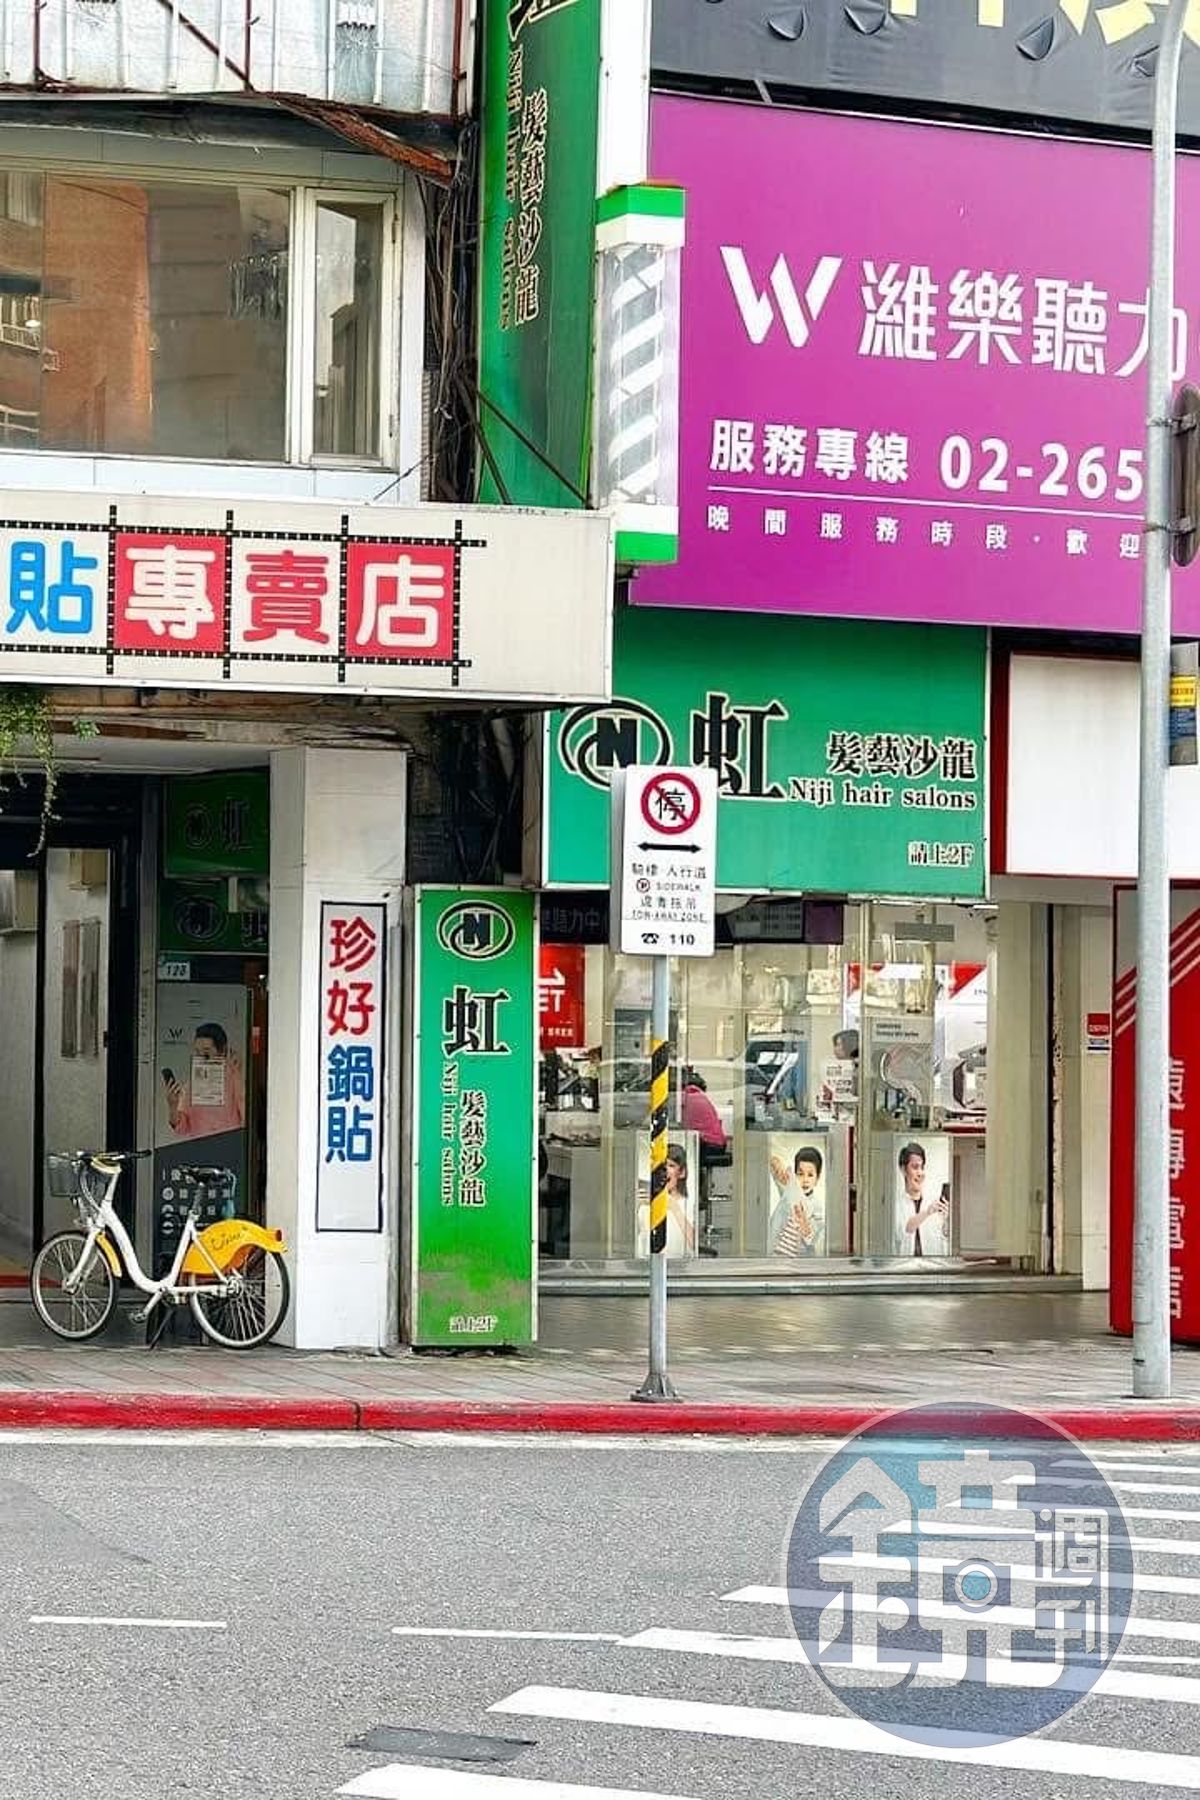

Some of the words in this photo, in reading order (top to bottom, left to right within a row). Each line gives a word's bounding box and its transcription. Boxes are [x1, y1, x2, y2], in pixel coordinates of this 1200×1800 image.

[515, 88, 547, 325] 髮藝沙龍
[709, 420, 909, 484] 服務專線
[693, 693, 788, 801] 虹
[828, 732, 978, 780] 髮藝沙龍
[790, 778, 836, 806] Niji
[843, 780, 892, 807] hair
[902, 783, 976, 809] salons
[669, 934, 695, 946] 110
[325, 916, 377, 1164] 珍好鍋貼
[443, 986, 511, 1056] 虹
[444, 1061, 458, 1097] Niji
[442, 1102, 456, 1140] hair
[459, 1091, 486, 1206] 髮藝沙龍
[441, 1148, 456, 1206] salons
